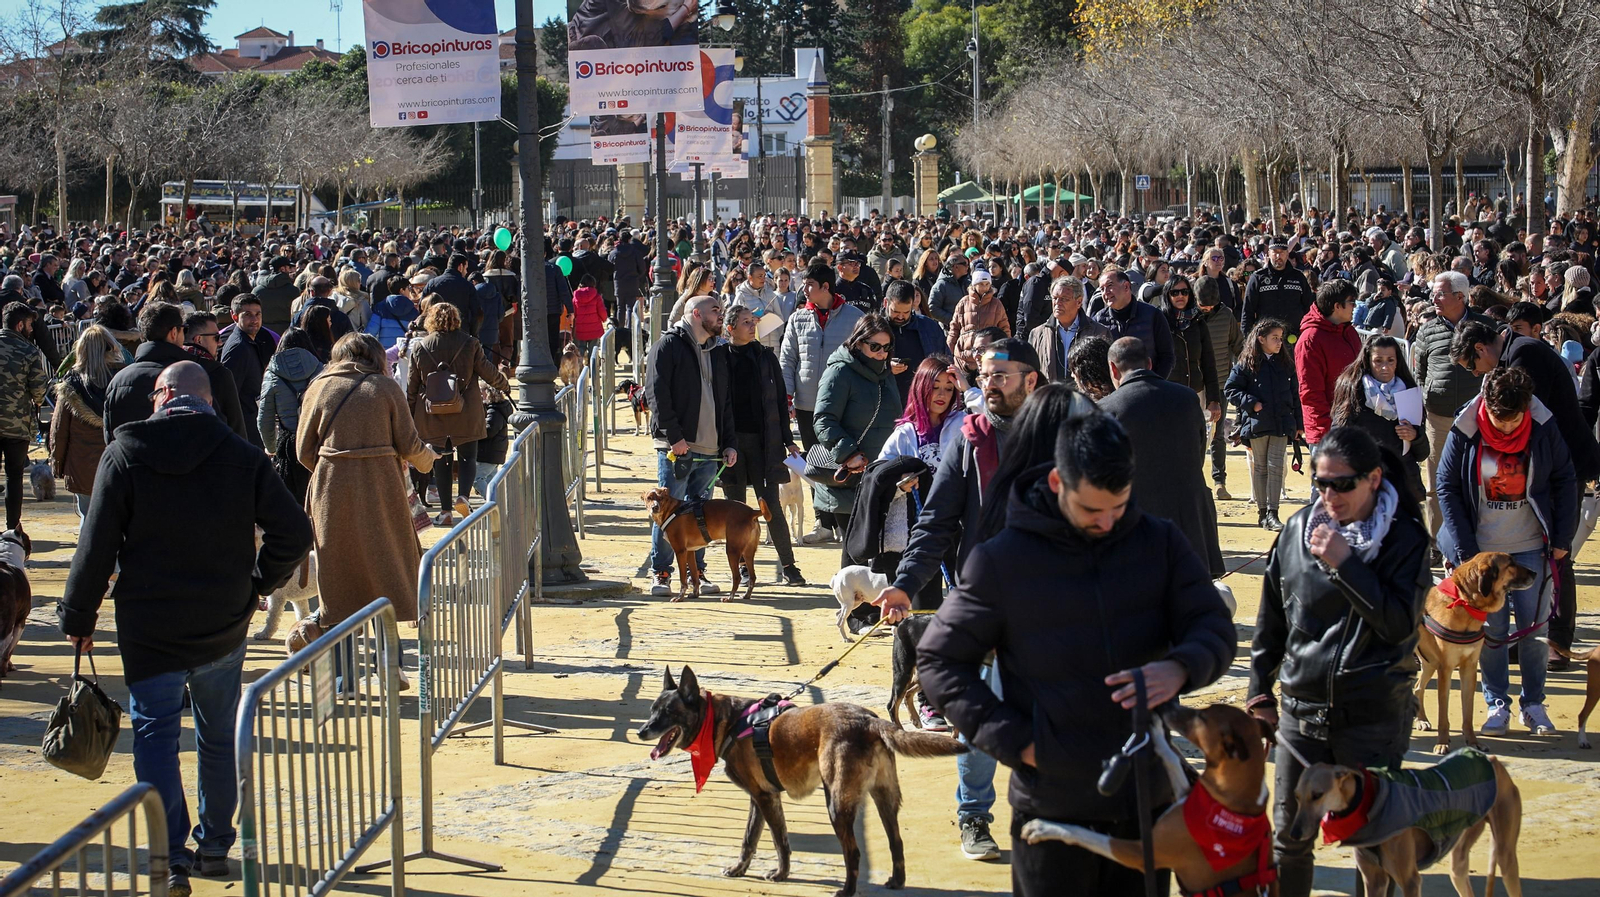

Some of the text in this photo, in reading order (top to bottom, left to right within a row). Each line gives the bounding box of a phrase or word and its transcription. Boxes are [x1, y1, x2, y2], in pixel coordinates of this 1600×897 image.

[392, 39, 492, 55] Bricopinturas
[396, 60, 460, 72] Profesionales
[595, 60, 694, 76] Bricopinturas
[397, 73, 447, 85] cerca de ti
[598, 86, 698, 98] www.bricopinturas.com
[398, 96, 496, 108] www.bricopinturas.com
[744, 108, 754, 118] lo
[602, 140, 646, 148] Bricopinturas
[1486, 501, 1504, 510] GIVE
[1506, 502, 1518, 510] ME
